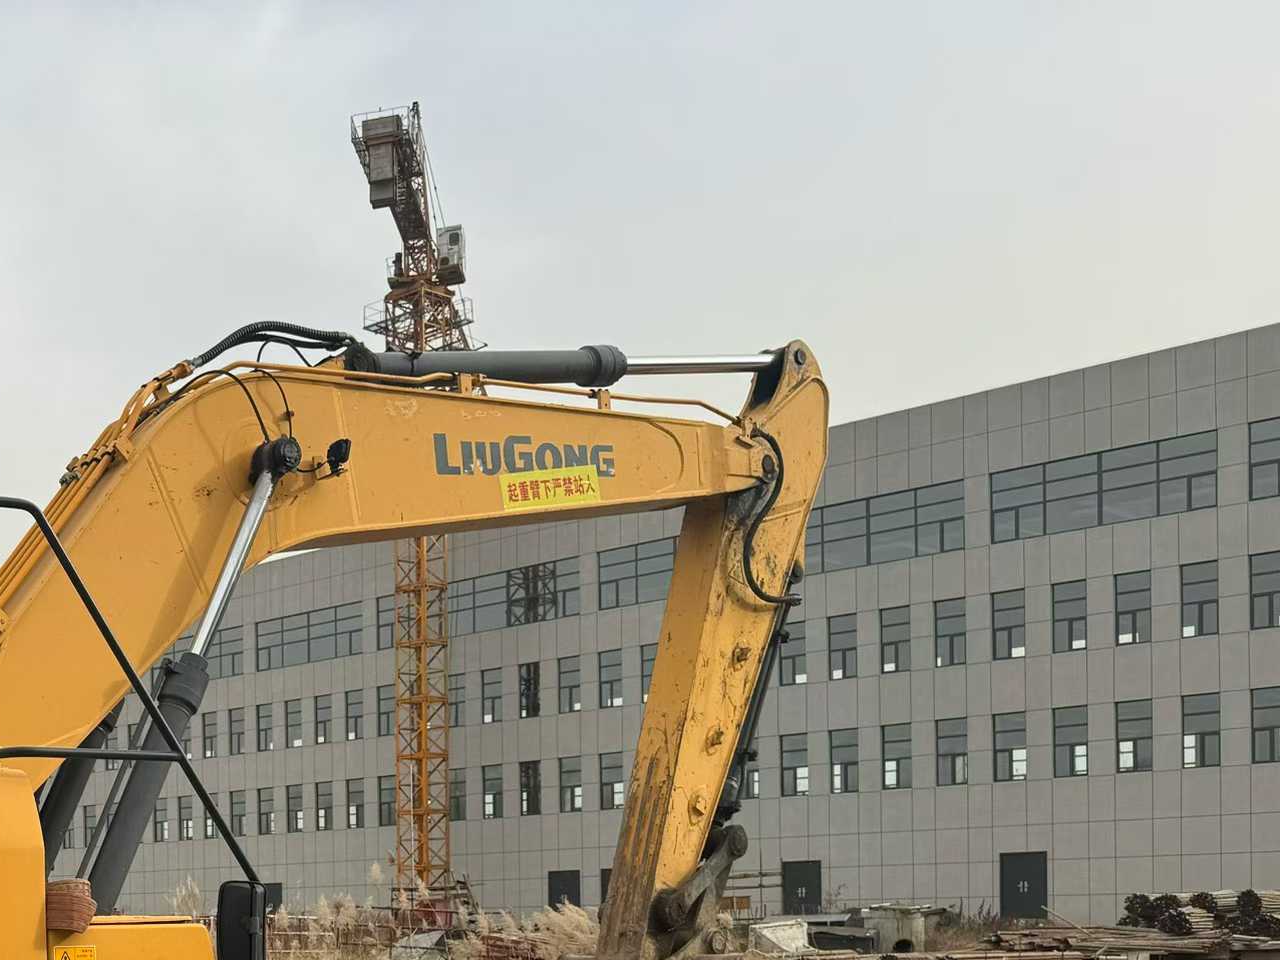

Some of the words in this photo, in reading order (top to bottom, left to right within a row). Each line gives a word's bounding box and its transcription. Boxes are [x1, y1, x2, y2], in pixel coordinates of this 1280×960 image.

[507, 475, 596, 502] 起重臂下严禁站人
